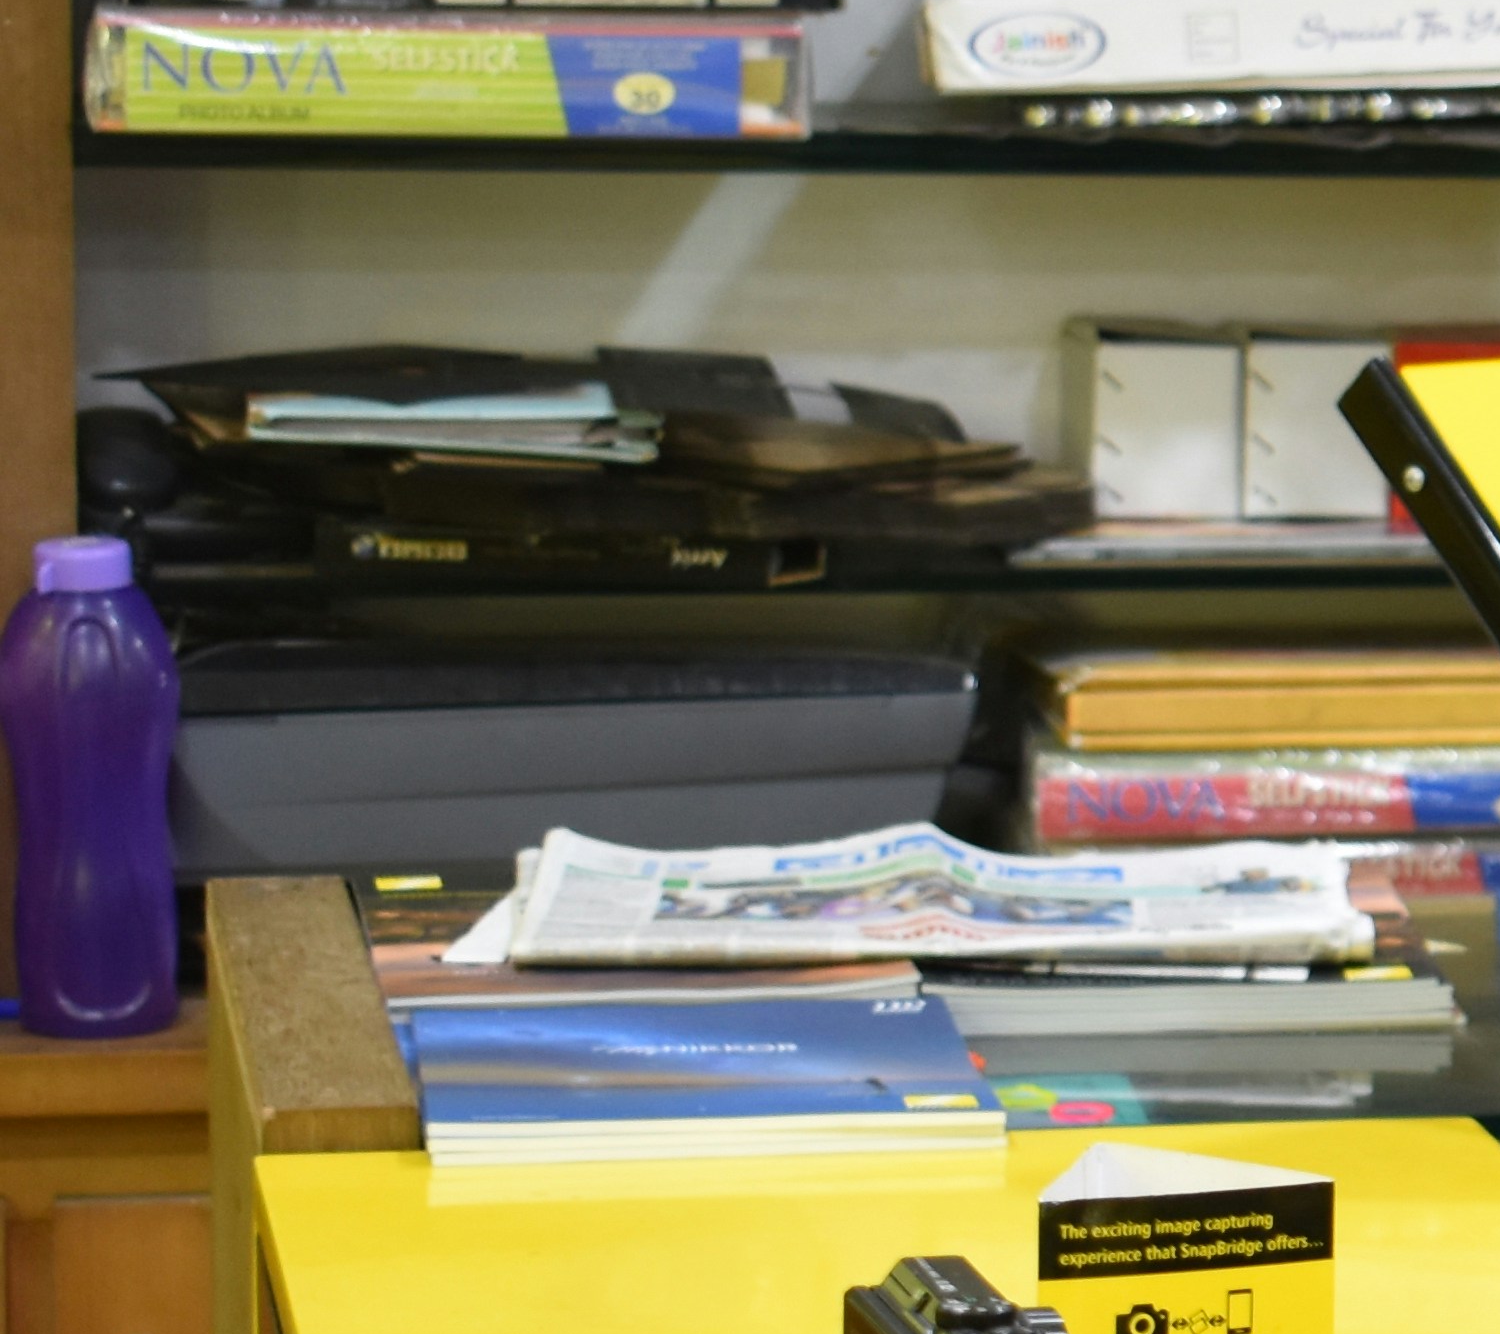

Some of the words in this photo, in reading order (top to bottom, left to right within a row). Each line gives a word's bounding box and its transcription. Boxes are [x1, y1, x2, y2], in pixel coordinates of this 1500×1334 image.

[140, 40, 348, 97] NOVA
[630, 91, 661, 109] 30
[1066, 779, 1225, 823] NOVA
[1060, 1224, 1087, 1240] The
[1092, 1222, 1152, 1239] exciting
[1155, 1220, 1201, 1235] image
[1204, 1213, 1274, 1232] capturing
[1059, 1250, 1141, 1268] experience
[1147, 1243, 1177, 1260] that
[1180, 1237, 1263, 1259] SnapBridge
